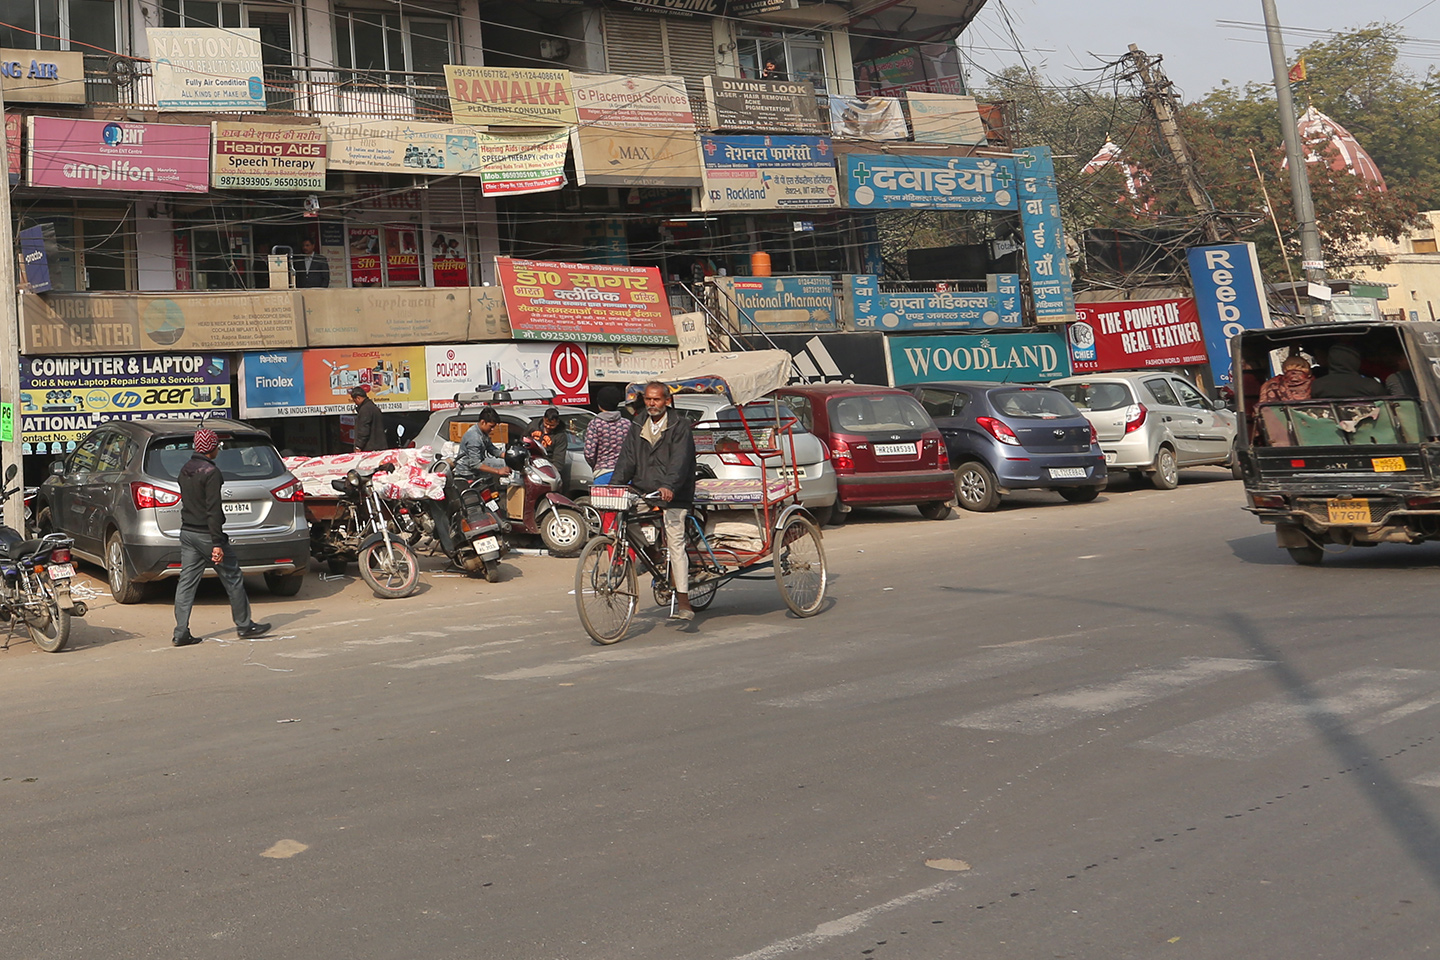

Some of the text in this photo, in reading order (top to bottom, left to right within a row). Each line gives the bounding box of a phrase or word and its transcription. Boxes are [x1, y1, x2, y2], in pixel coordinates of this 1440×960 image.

[155, 38, 259, 58] NATIONAL
[453, 79, 569, 105] RAWALKA
[722, 81, 806, 94] DIVINE LOOK
[589, 90, 687, 105] Placement Services
[224, 142, 320, 156] Hearing Aids
[725, 147, 767, 160] नेशनल
[229, 156, 268, 166] Speech
[271, 157, 315, 169] Therapy
[62, 159, 155, 185] amplifon
[221, 177, 321, 187] 9871393905, 9650305101
[727, 188, 766, 200] Rockland
[568, 273, 648, 289] सागर
[516, 287, 620, 302] भारत क्लीनिक
[737, 293, 832, 311] National Pharmacy
[47, 299, 114, 318] GURGAON
[890, 297, 925, 315] गुप्ता
[1206, 250, 1245, 358] Reebo
[1098, 308, 1159, 335] THE POWER
[32, 324, 133, 347] ENT CENTER
[610, 334, 670, 342] 09588705875
[1122, 322, 1201, 353] REAL LEATHER
[905, 345, 1058, 376] WOODLAND
[1074, 350, 1095, 360] CHIEF
[31, 356, 204, 377] COMPUTER & LAPTOP
[437, 363, 467, 377] POLYCAB
[31, 379, 47, 387] Old
[57, 378, 78, 386] New
[79, 378, 109, 386] Laptop
[111, 377, 139, 385] Repair
[168, 376, 204, 384] Services
[256, 377, 293, 388] Finolex
[117, 389, 191, 407] hp acer
[2, 407, 11, 418] PG
[235, 504, 249, 512] 1874
